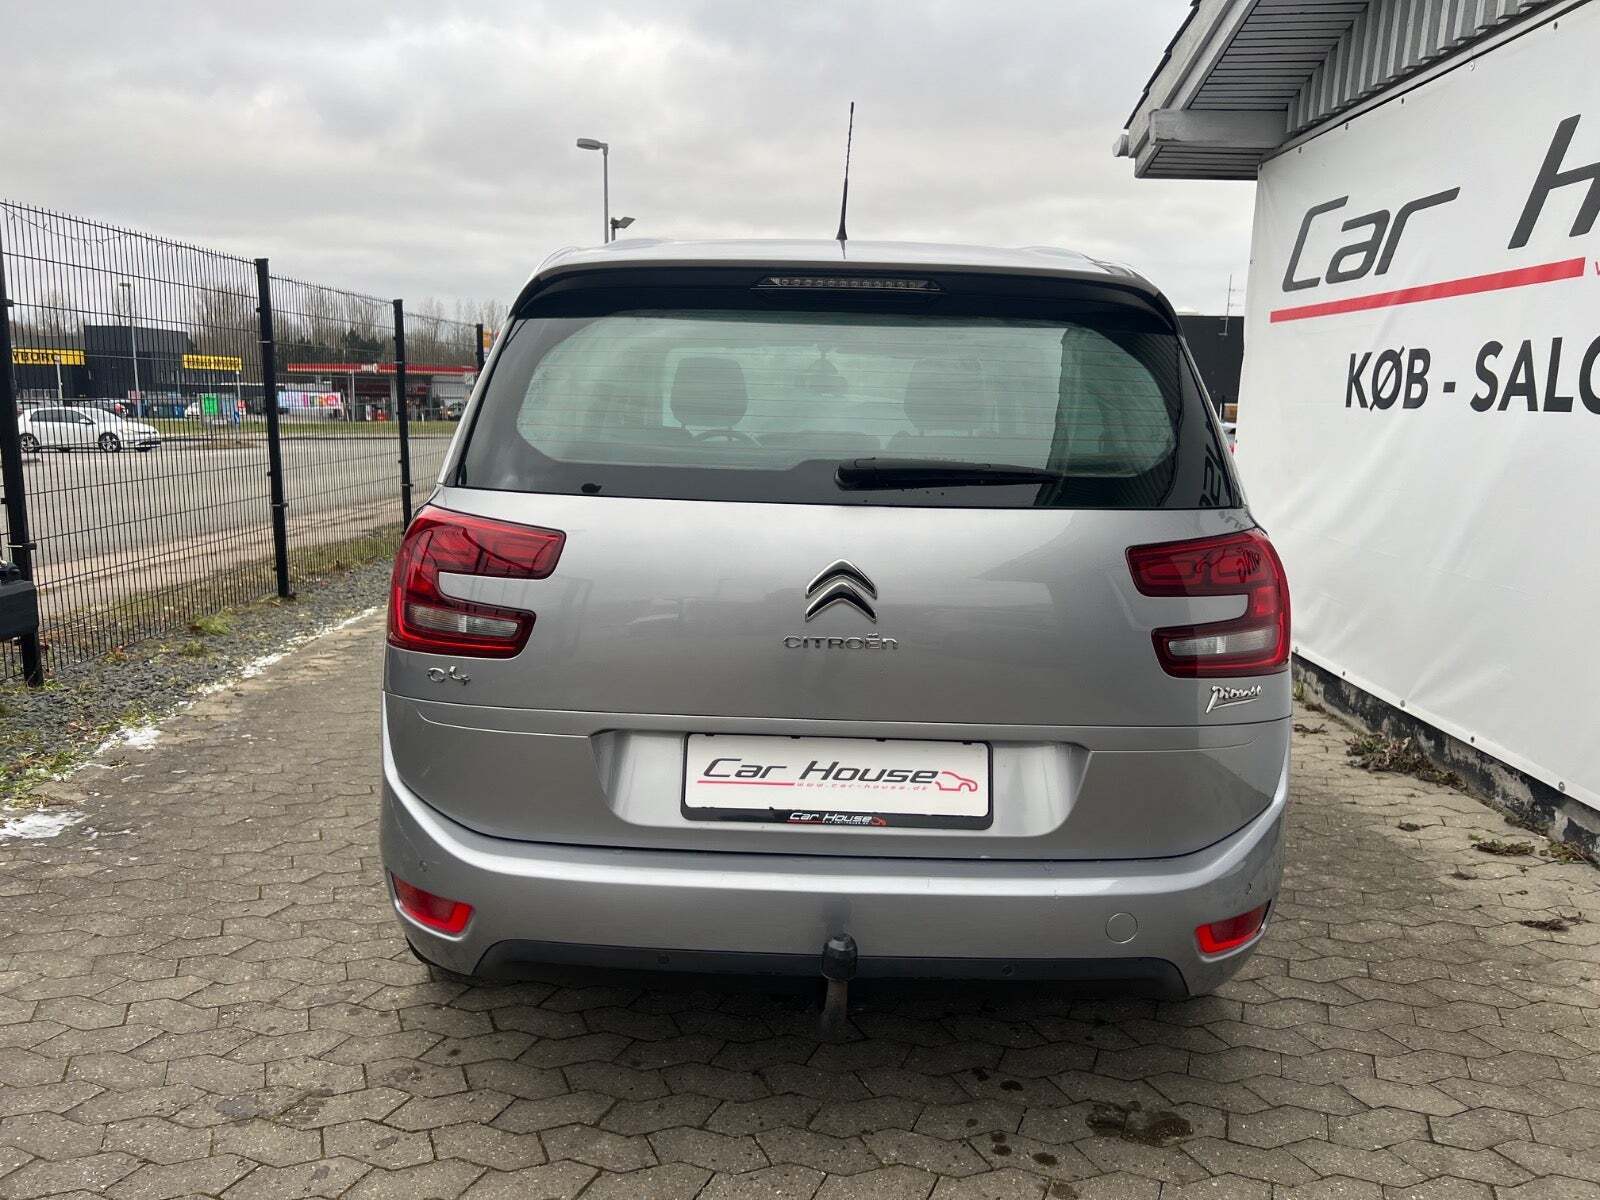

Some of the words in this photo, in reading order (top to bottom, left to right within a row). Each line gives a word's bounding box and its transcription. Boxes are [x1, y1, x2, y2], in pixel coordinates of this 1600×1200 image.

[1282, 186, 1461, 292] Car
[1345, 345, 1431, 411] KØB
[427, 665, 471, 686] C4
[703, 758, 788, 778] Car
[798, 760, 939, 784] House
[789, 812, 819, 820] Car
[822, 813, 872, 823] House
